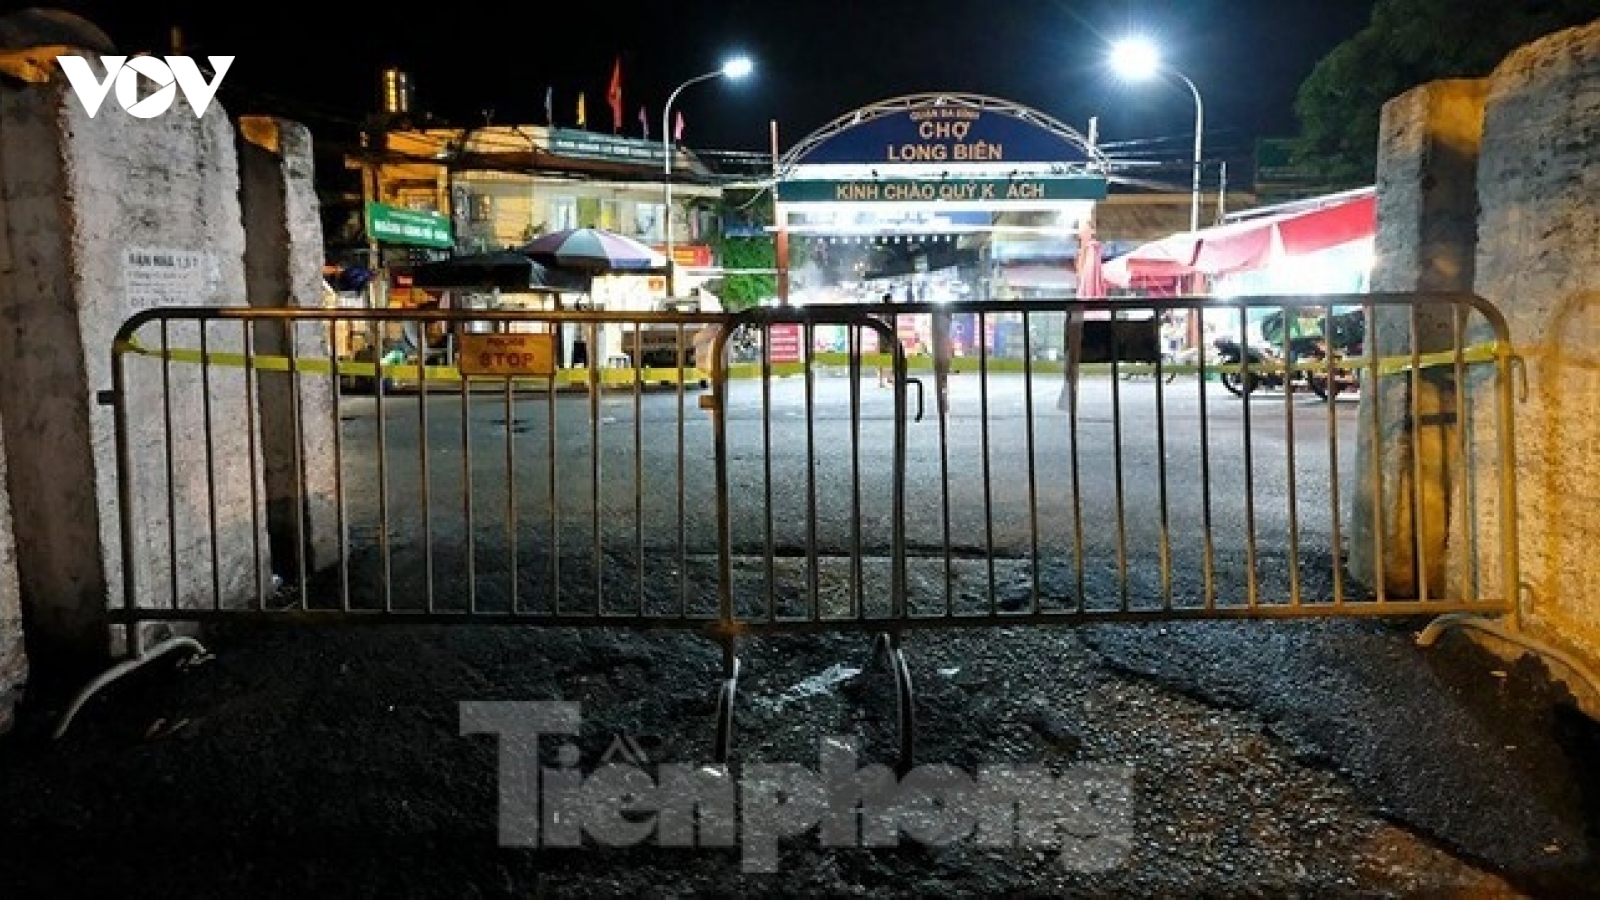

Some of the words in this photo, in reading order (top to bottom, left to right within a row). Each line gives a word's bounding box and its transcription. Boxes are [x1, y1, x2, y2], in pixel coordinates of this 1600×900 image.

[919, 121, 970, 141] CHỢ
[888, 144, 947, 160] LONG
[954, 140, 1002, 160] BIÊN
[884, 181, 935, 200] CHÀO
[479, 353, 534, 367] STOP
